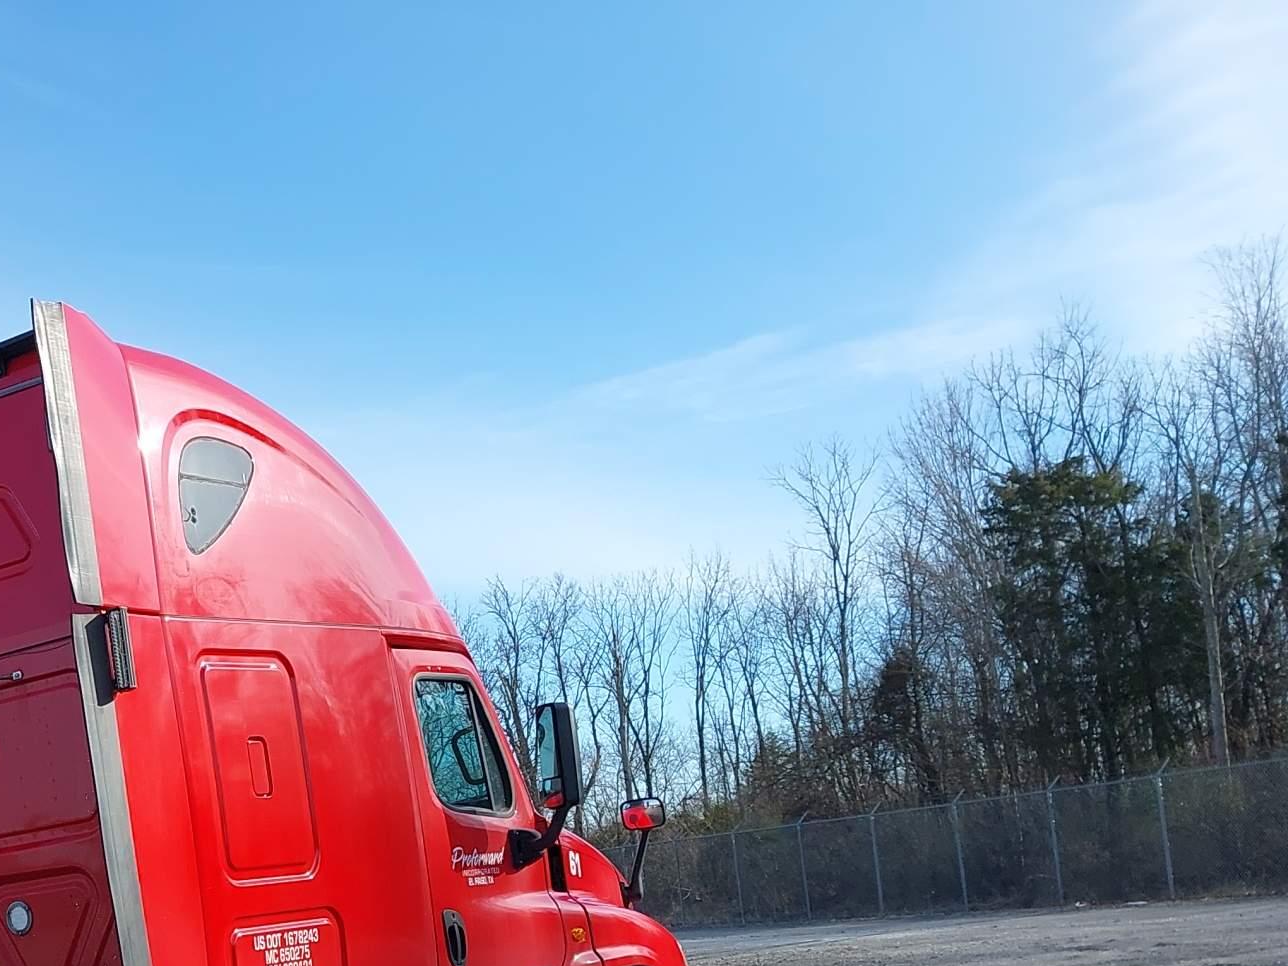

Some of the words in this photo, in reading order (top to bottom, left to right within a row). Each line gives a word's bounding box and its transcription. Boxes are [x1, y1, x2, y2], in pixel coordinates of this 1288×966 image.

[568, 850, 582, 878] 61
[254, 935, 266, 950] US
[266, 932, 282, 949] DOT
[283, 928, 319, 945] 1678243
[265, 949, 279, 964] MC
[280, 945, 311, 962] 650275
